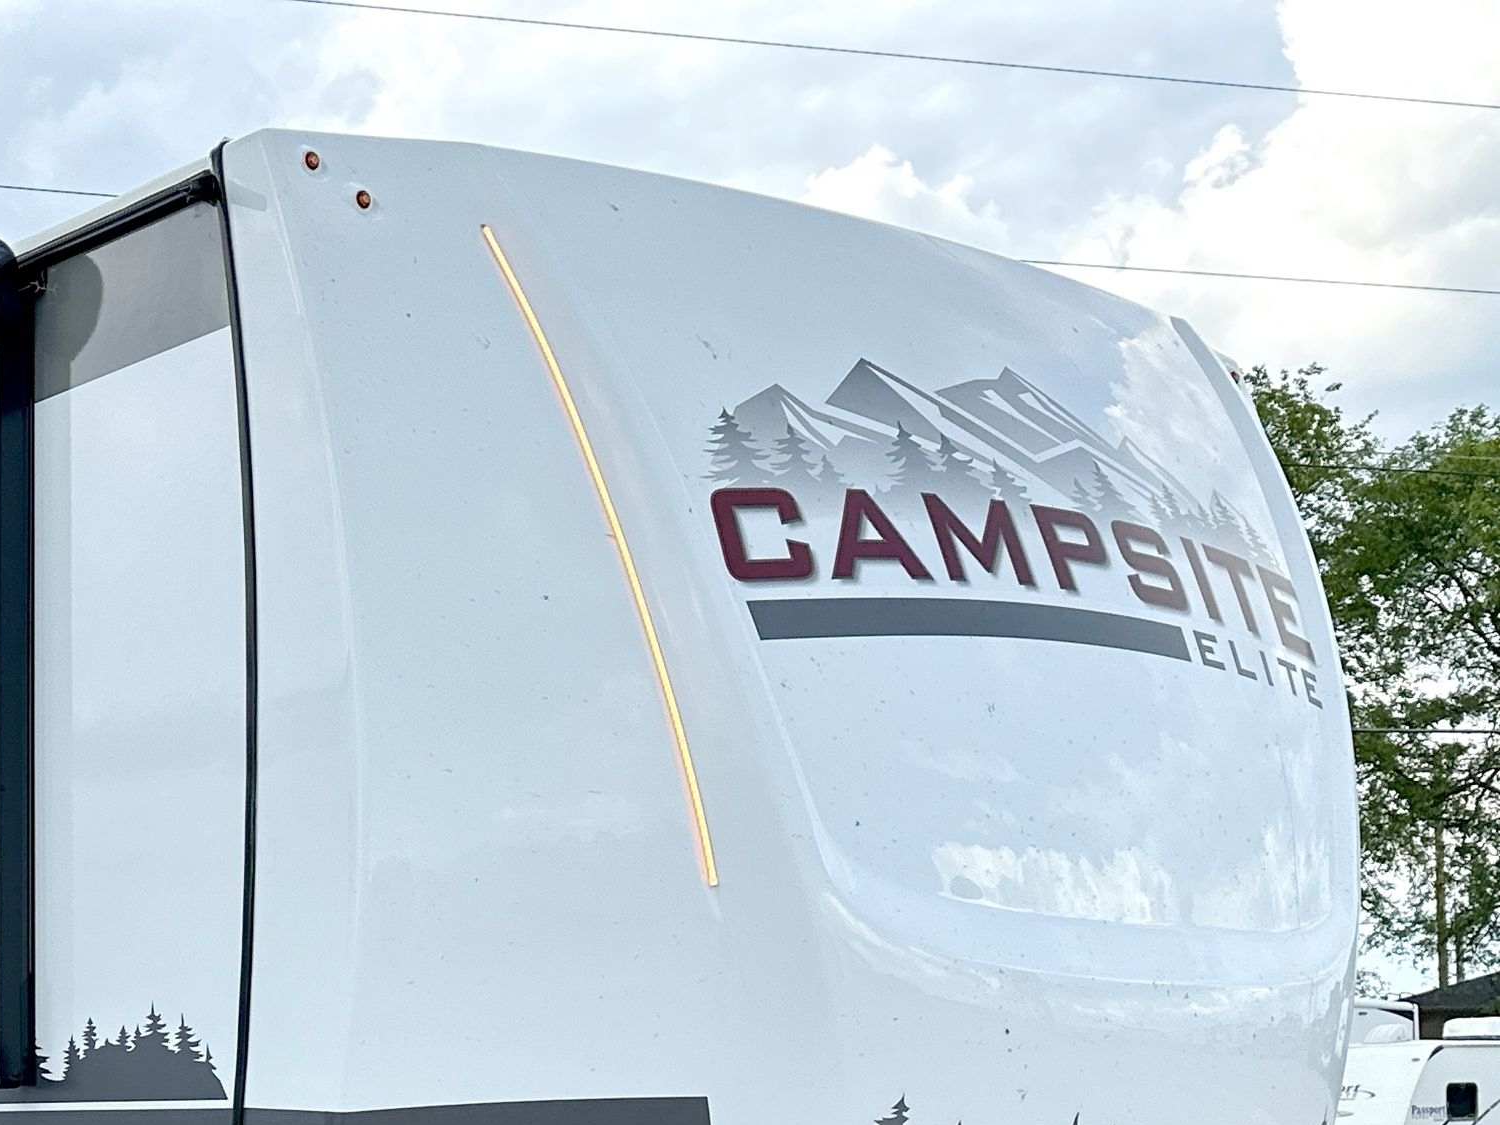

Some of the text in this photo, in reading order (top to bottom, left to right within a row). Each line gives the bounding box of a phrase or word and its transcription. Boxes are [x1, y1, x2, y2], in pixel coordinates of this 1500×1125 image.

[710, 487, 1316, 664] CAMPSITE
[1193, 630, 1323, 709] ELITE
[1411, 1105, 1446, 1117] Passport
